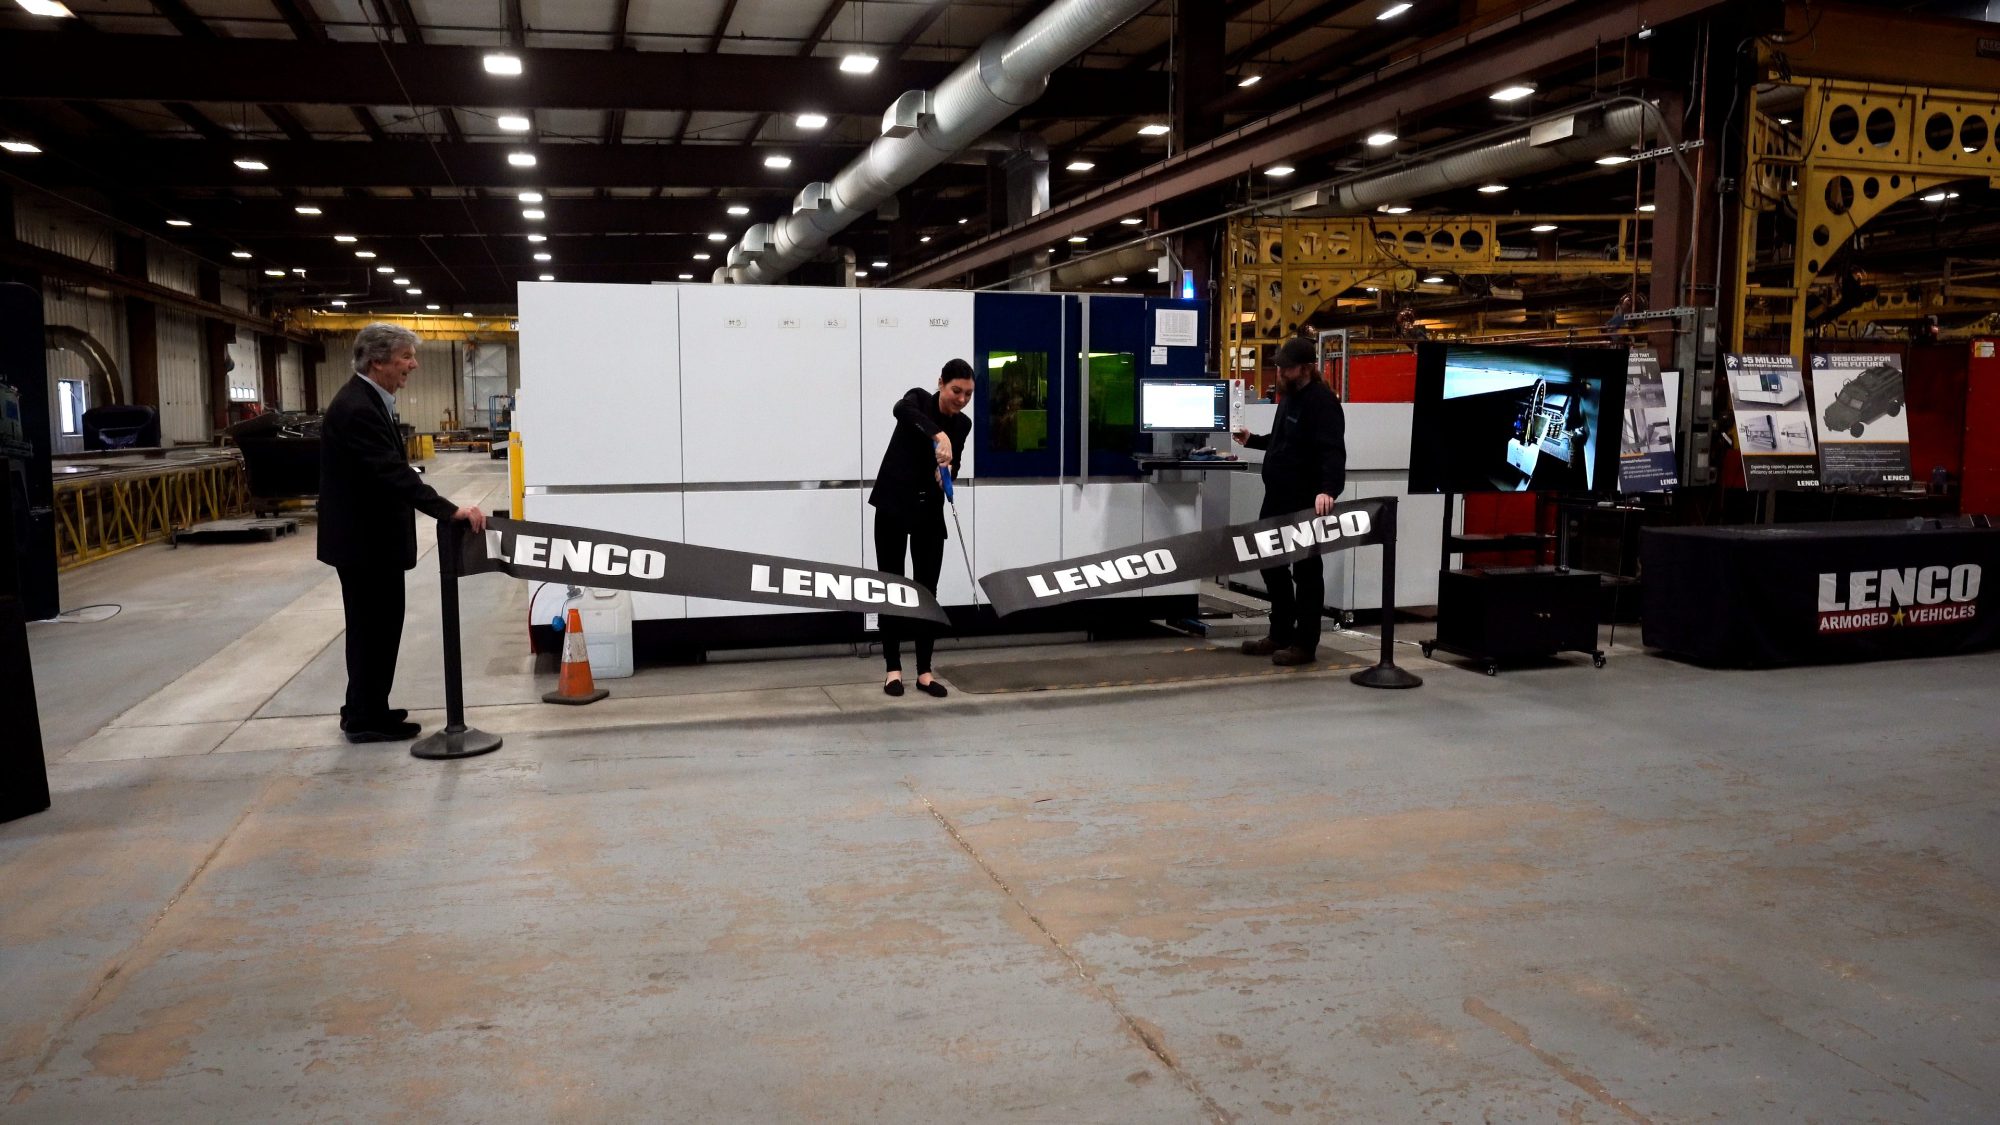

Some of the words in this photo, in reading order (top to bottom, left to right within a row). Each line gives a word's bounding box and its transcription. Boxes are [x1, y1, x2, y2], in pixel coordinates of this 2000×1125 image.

[1754, 356, 1792, 364] MILLION
[1660, 478, 1678, 486] LENCO
[485, 529, 665, 580] LENCO
[1232, 510, 1371, 562] LENCO
[750, 564, 920, 608] LENCO
[1026, 548, 1178, 598] LENCO
[1817, 563, 1982, 613] LENCO
[1819, 612, 1889, 631] ARMORED
[1909, 605, 1976, 623] VEHICLES
